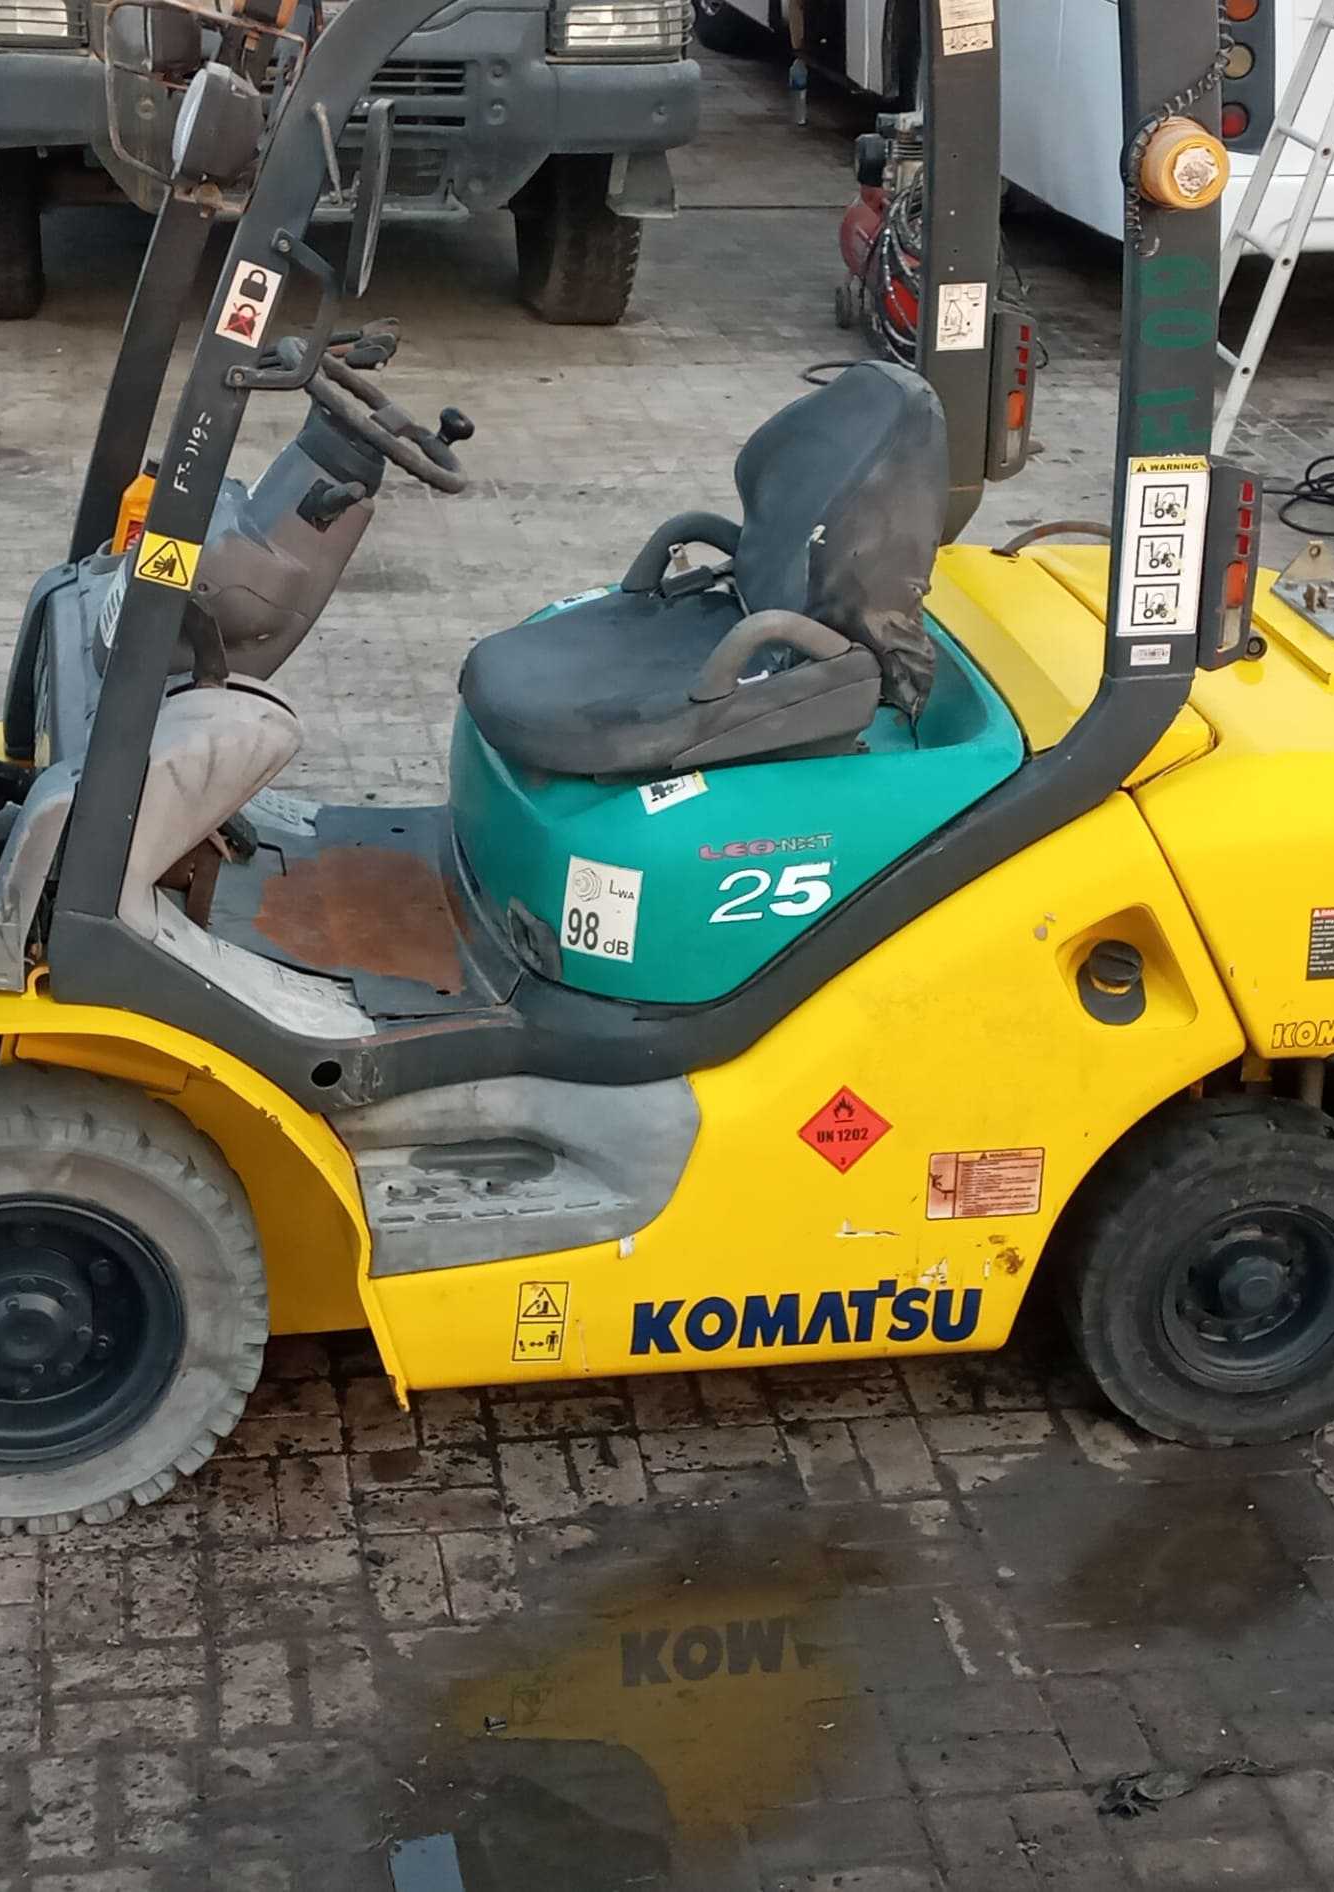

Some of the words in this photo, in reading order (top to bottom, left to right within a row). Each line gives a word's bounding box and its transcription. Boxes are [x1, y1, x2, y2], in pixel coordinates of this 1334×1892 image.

[1150, 462, 1199, 471] WARNING
[708, 861, 832, 924] 25
[566, 906, 600, 951] 98
[603, 938, 629, 956] dB
[837, 1127, 869, 1143] 1202
[630, 1278, 983, 1356] KOMATSU
